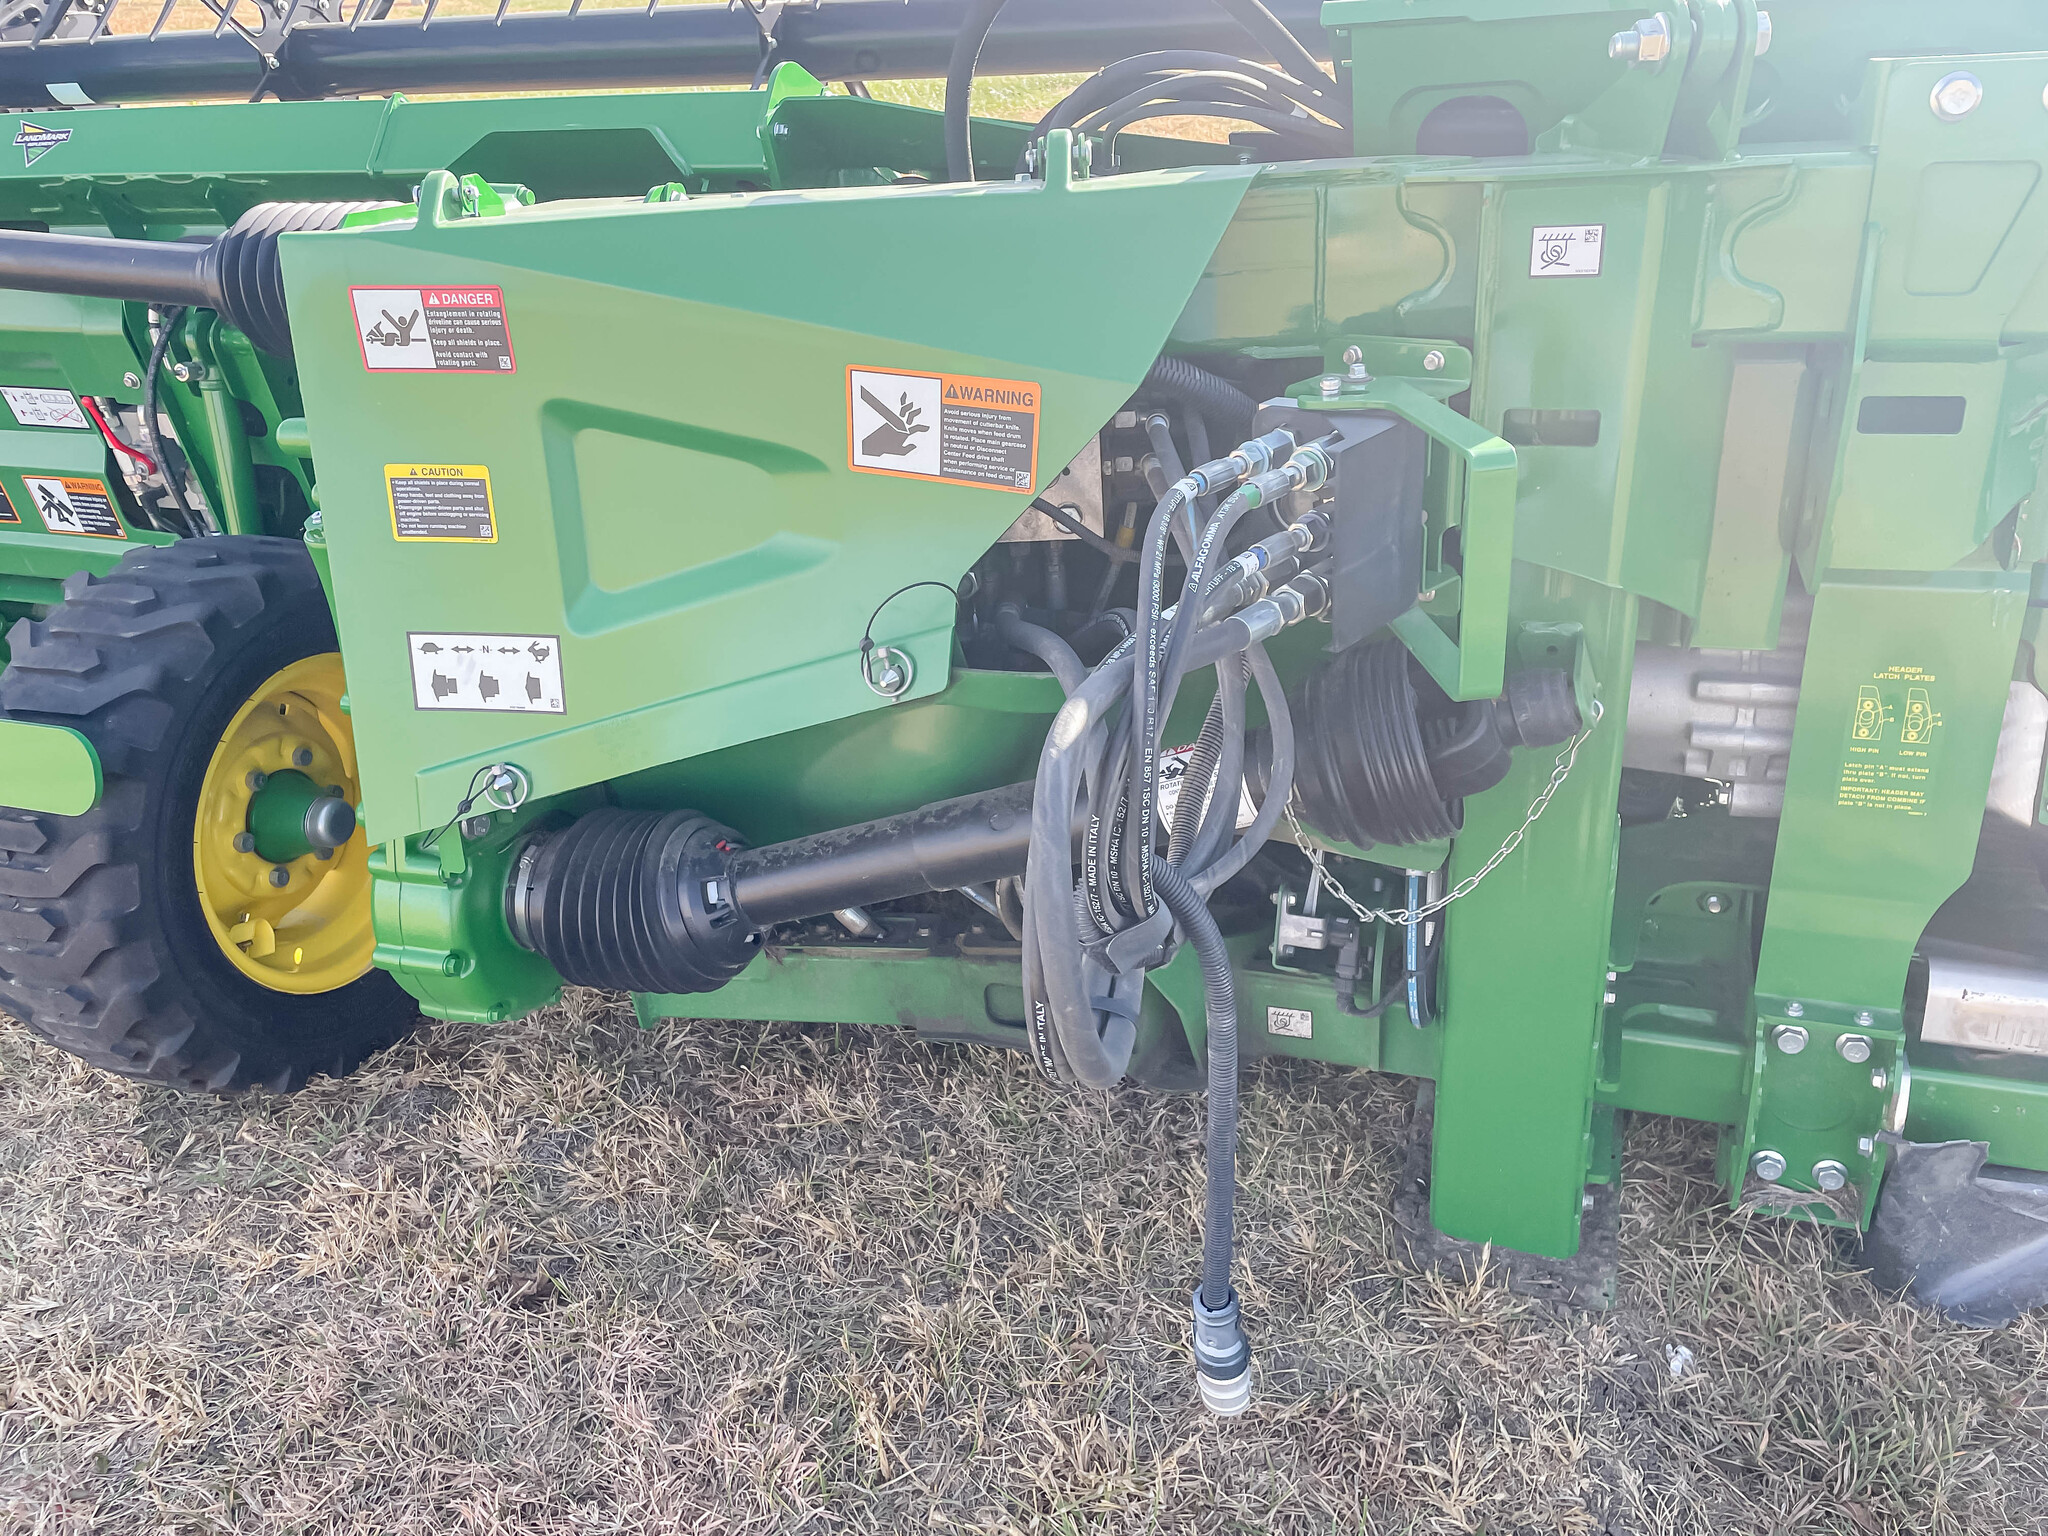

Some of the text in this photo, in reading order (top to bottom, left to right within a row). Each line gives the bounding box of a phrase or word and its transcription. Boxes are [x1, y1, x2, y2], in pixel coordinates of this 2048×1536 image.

[443, 293, 493, 304] DANGER
[960, 386, 1034, 407] WARNING
[976, 446, 1007, 454] Disconnect
[422, 468, 463, 476] CAUTION
[958, 461, 988, 470] performing
[71, 481, 104, 491] WARNING
[1171, 490, 1184, 511] ERTUFF
[1194, 522, 1221, 583] ALFAGOMMA
[1228, 492, 1241, 504] SUP
[1152, 562, 1161, 578] MPa
[1205, 574, 1224, 595] RTUFF
[1888, 666, 1923, 674] HEADER
[1146, 718, 1154, 736] R17
[1144, 748, 1153, 762] EN
[1144, 765, 1152, 783] 857
[1160, 782, 1180, 790] ROTAT
[1141, 809, 1149, 825] DN
[1089, 814, 1100, 844] ITALY
[1141, 826, 1149, 837] 10
[1088, 846, 1096, 857] IN
[1110, 838, 1119, 865] MSHA
[1141, 845, 1150, 871] MSHA
[1088, 859, 1097, 886] MADE
[1036, 1001, 1046, 1030] ITALY
[1038, 1033, 1046, 1043] IN
